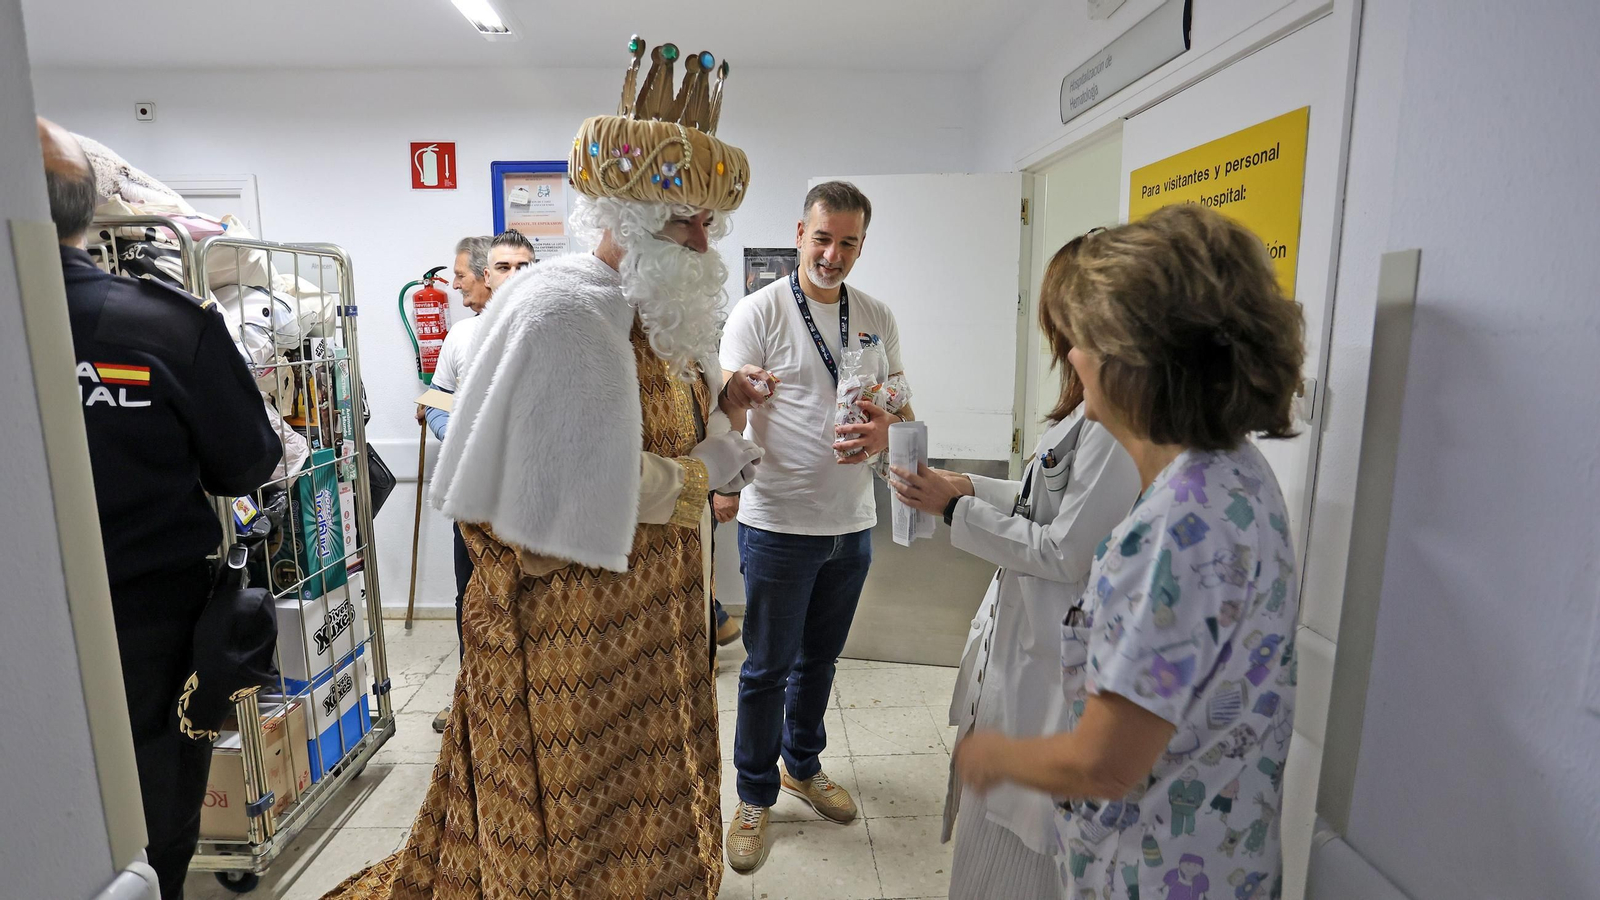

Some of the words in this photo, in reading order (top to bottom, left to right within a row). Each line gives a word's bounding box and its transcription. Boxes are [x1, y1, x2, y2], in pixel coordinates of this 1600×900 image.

[1105, 54, 1113, 69] de
[1069, 83, 1099, 111] Hematología
[1141, 184, 1161, 199] Para
[1163, 168, 1210, 193] visitantes
[1214, 164, 1221, 180] y
[1225, 142, 1280, 176] personal
[1200, 184, 1247, 208] hospital:
[202, 790, 228, 808] RO
